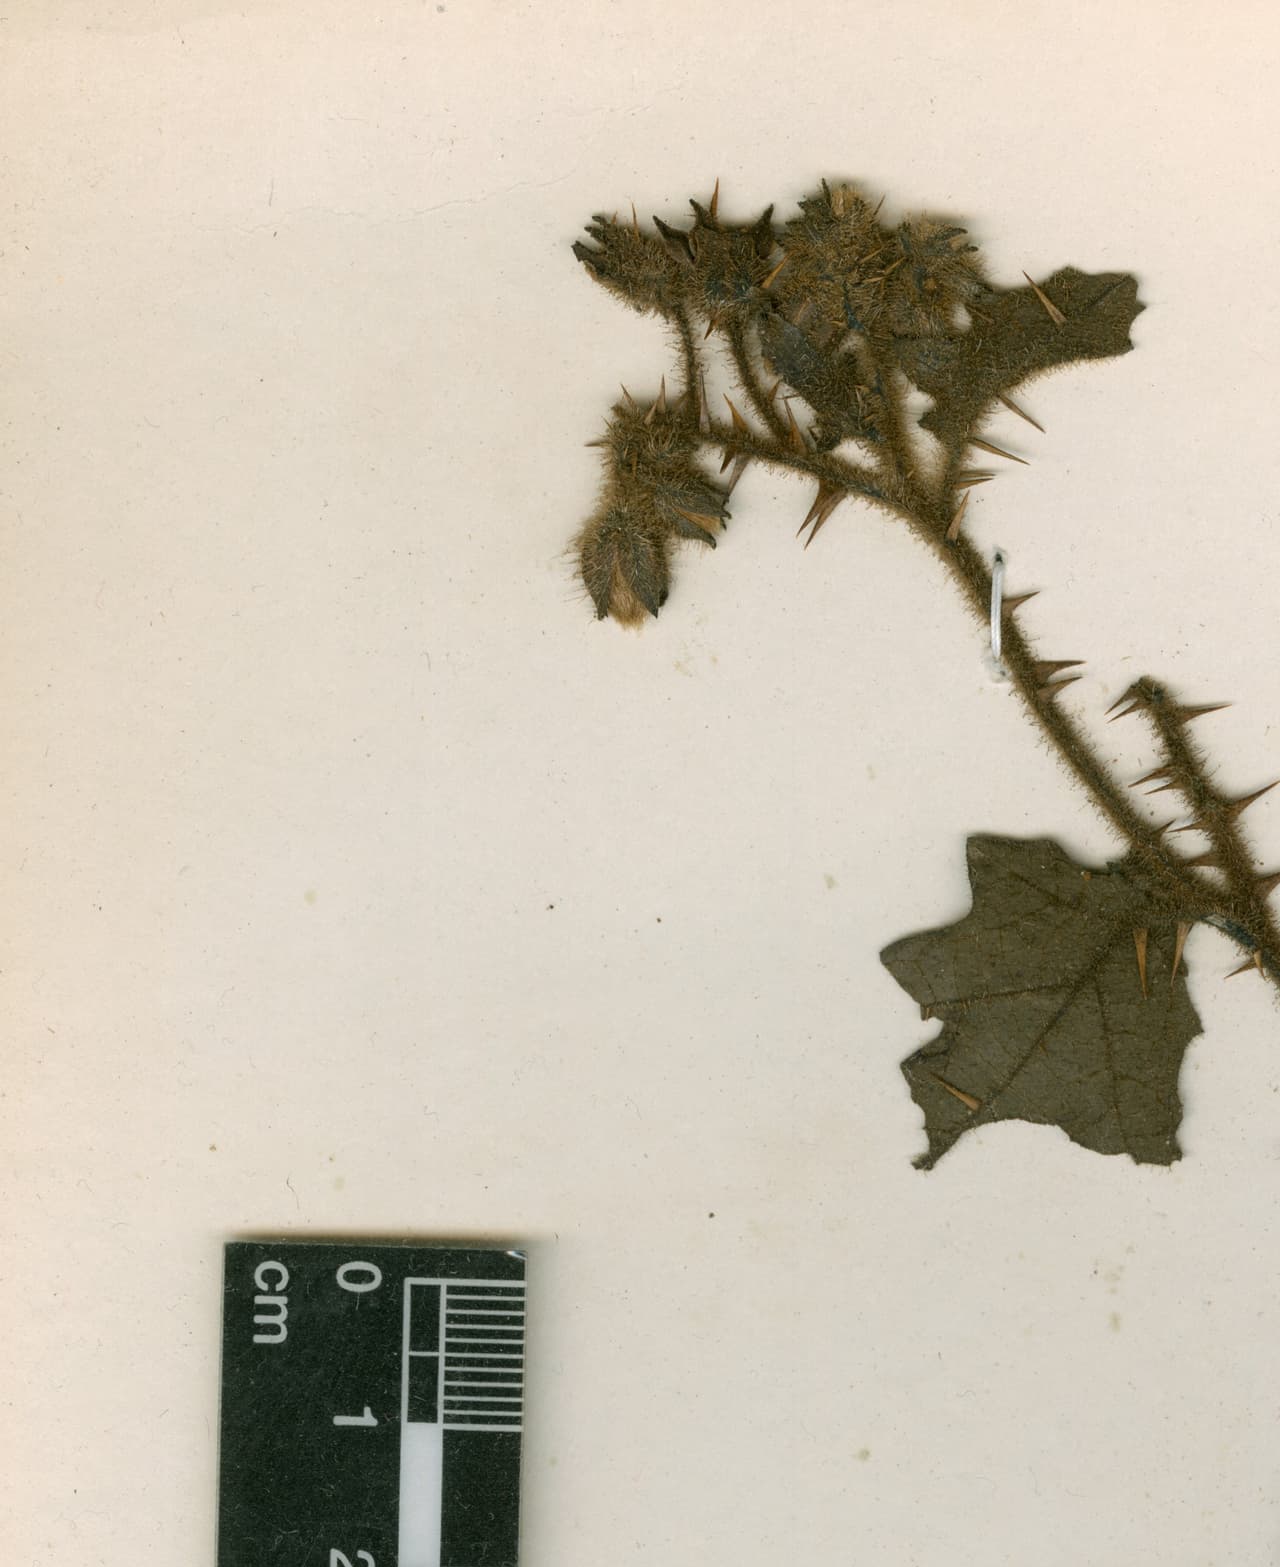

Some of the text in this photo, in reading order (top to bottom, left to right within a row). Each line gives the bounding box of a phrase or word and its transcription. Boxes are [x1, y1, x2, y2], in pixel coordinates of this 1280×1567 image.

[336, 1261, 382, 1293] 0
[253, 1261, 289, 1343] cm
[333, 1407, 378, 1426] 1
